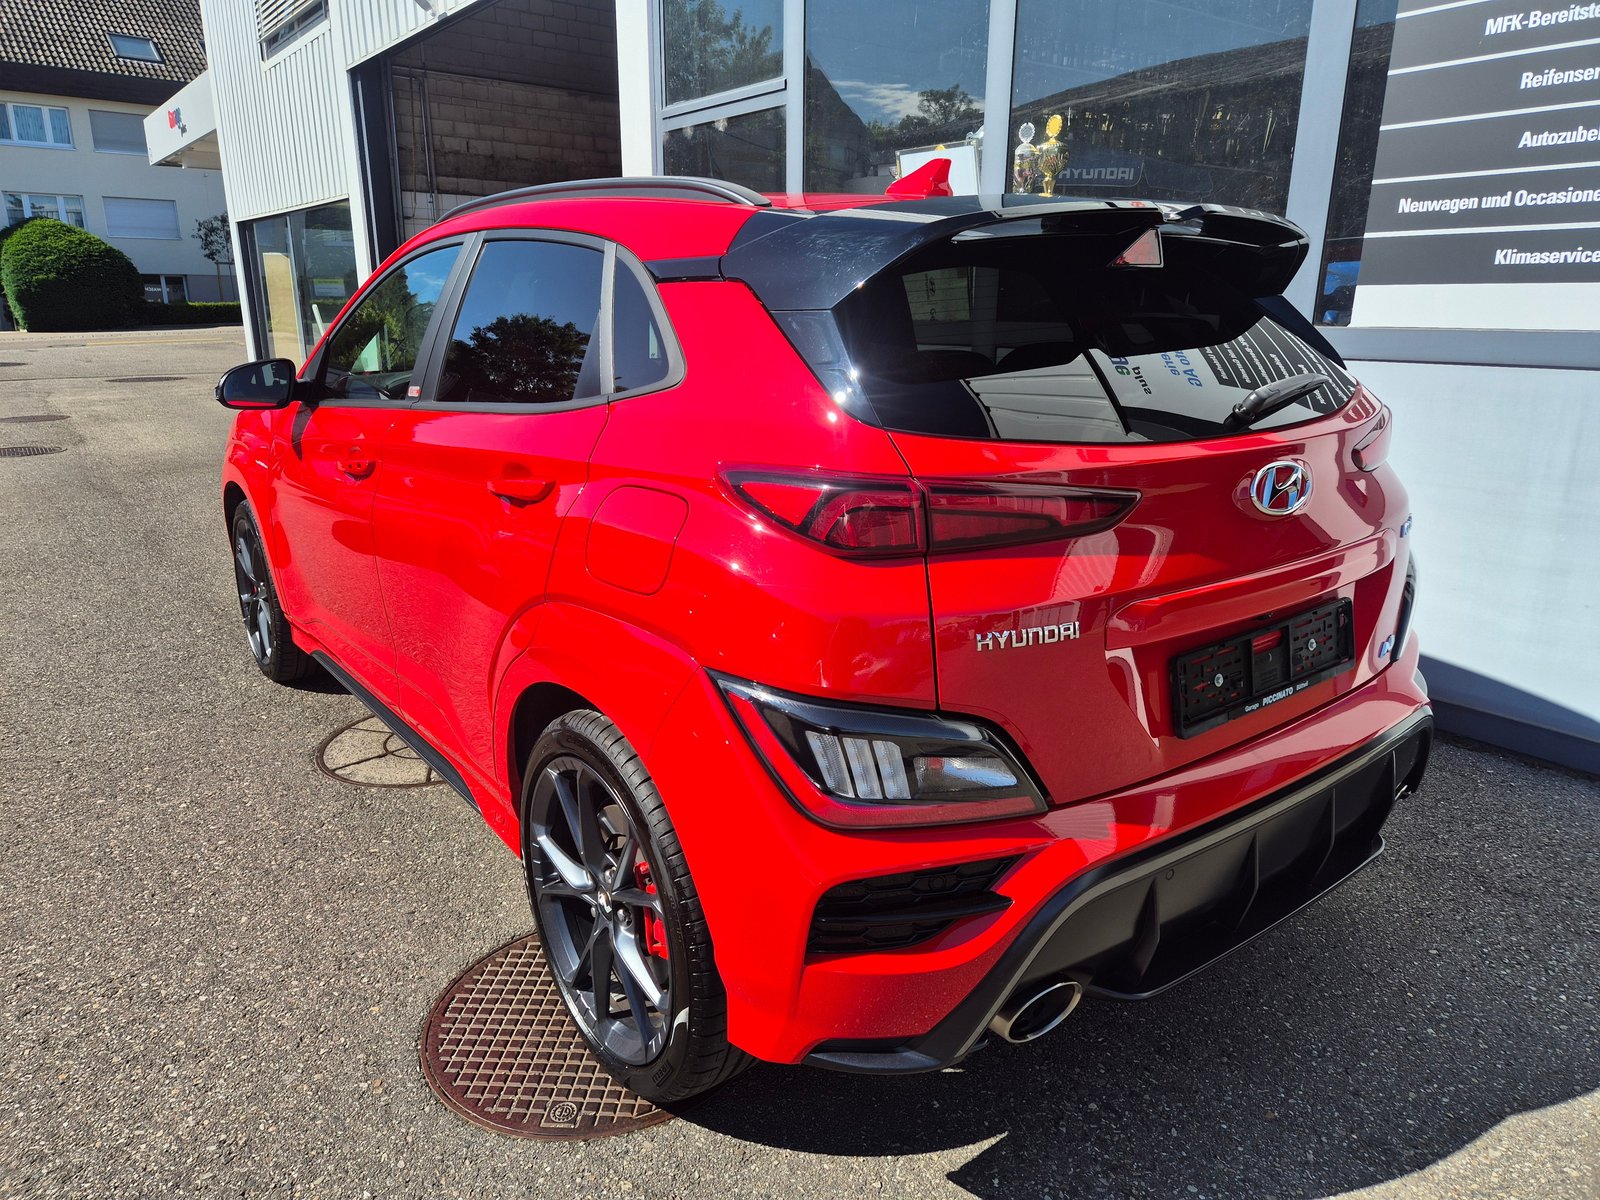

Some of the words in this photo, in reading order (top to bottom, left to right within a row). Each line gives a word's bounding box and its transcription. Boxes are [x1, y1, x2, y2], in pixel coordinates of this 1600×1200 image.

[1058, 167, 1135, 181] HYUNDAI
[1398, 197, 1478, 214] Neuwagen
[1481, 191, 1512, 209] und
[1494, 246, 1600, 265] Klimaservice
[976, 621, 1080, 651] HYUNDAI
[1244, 702, 1260, 712] Garage
[1262, 686, 1294, 706] PICCINATO
